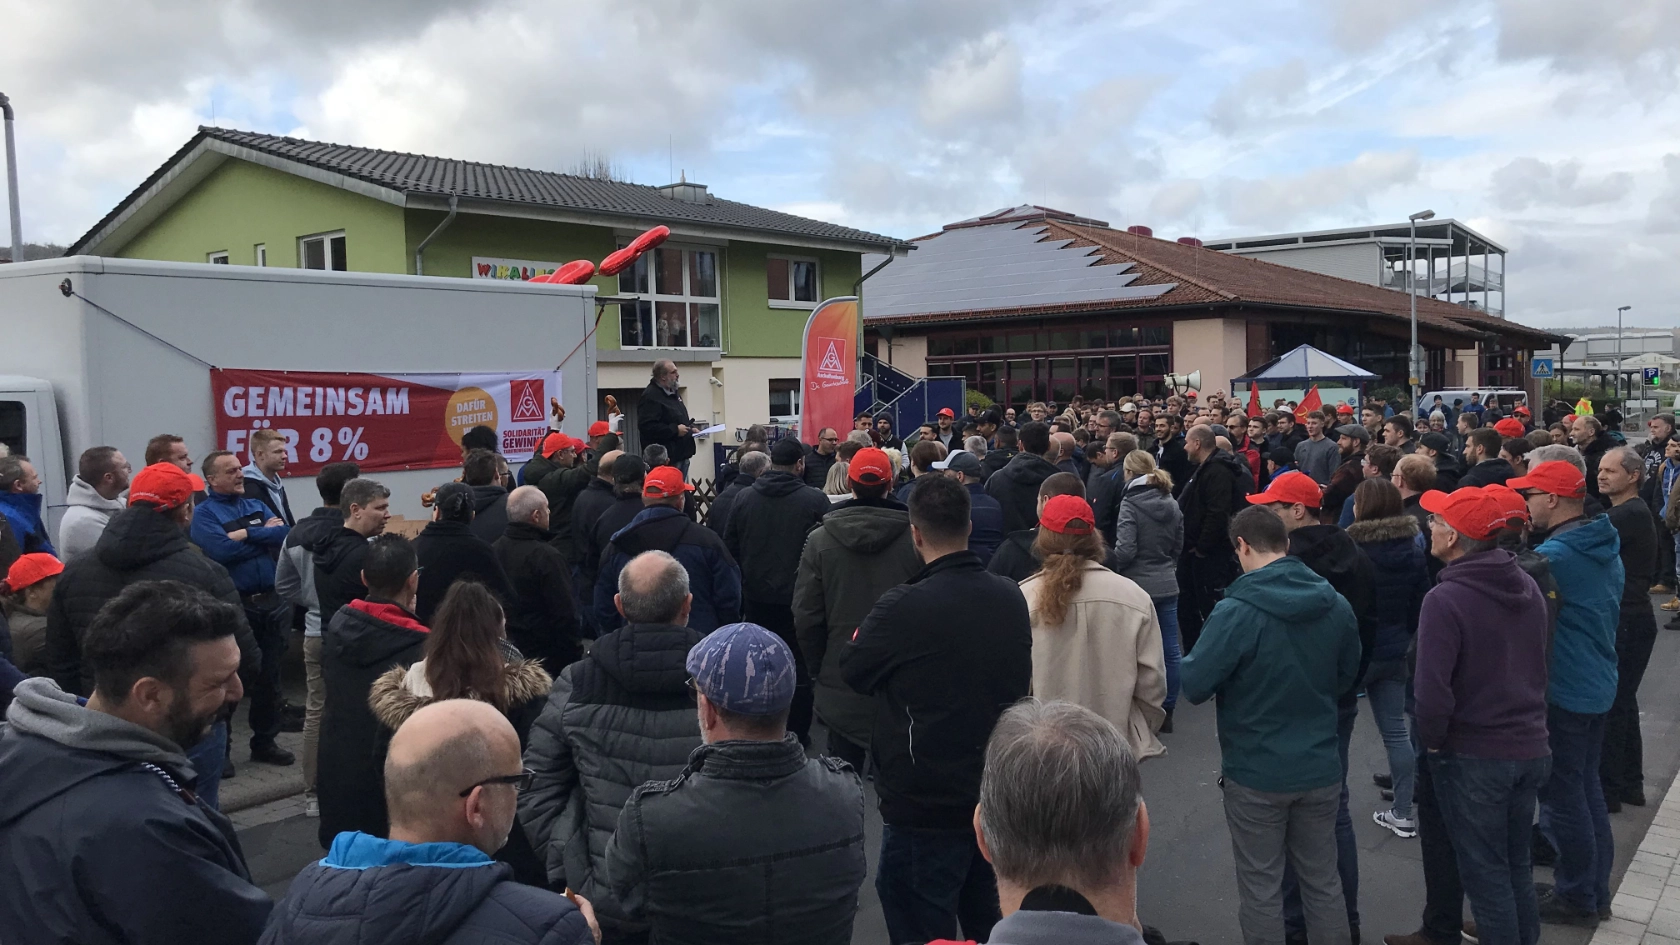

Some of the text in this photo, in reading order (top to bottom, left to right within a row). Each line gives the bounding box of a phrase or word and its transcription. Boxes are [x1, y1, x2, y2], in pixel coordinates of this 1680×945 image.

[223, 386, 410, 417] GEMEINSAM
[456, 398, 486, 413] DAFÜR
[451, 411, 493, 427] STREITEN
[503, 427, 545, 438] SOLIDARITÄT
[502, 436, 544, 449] GEWINN
